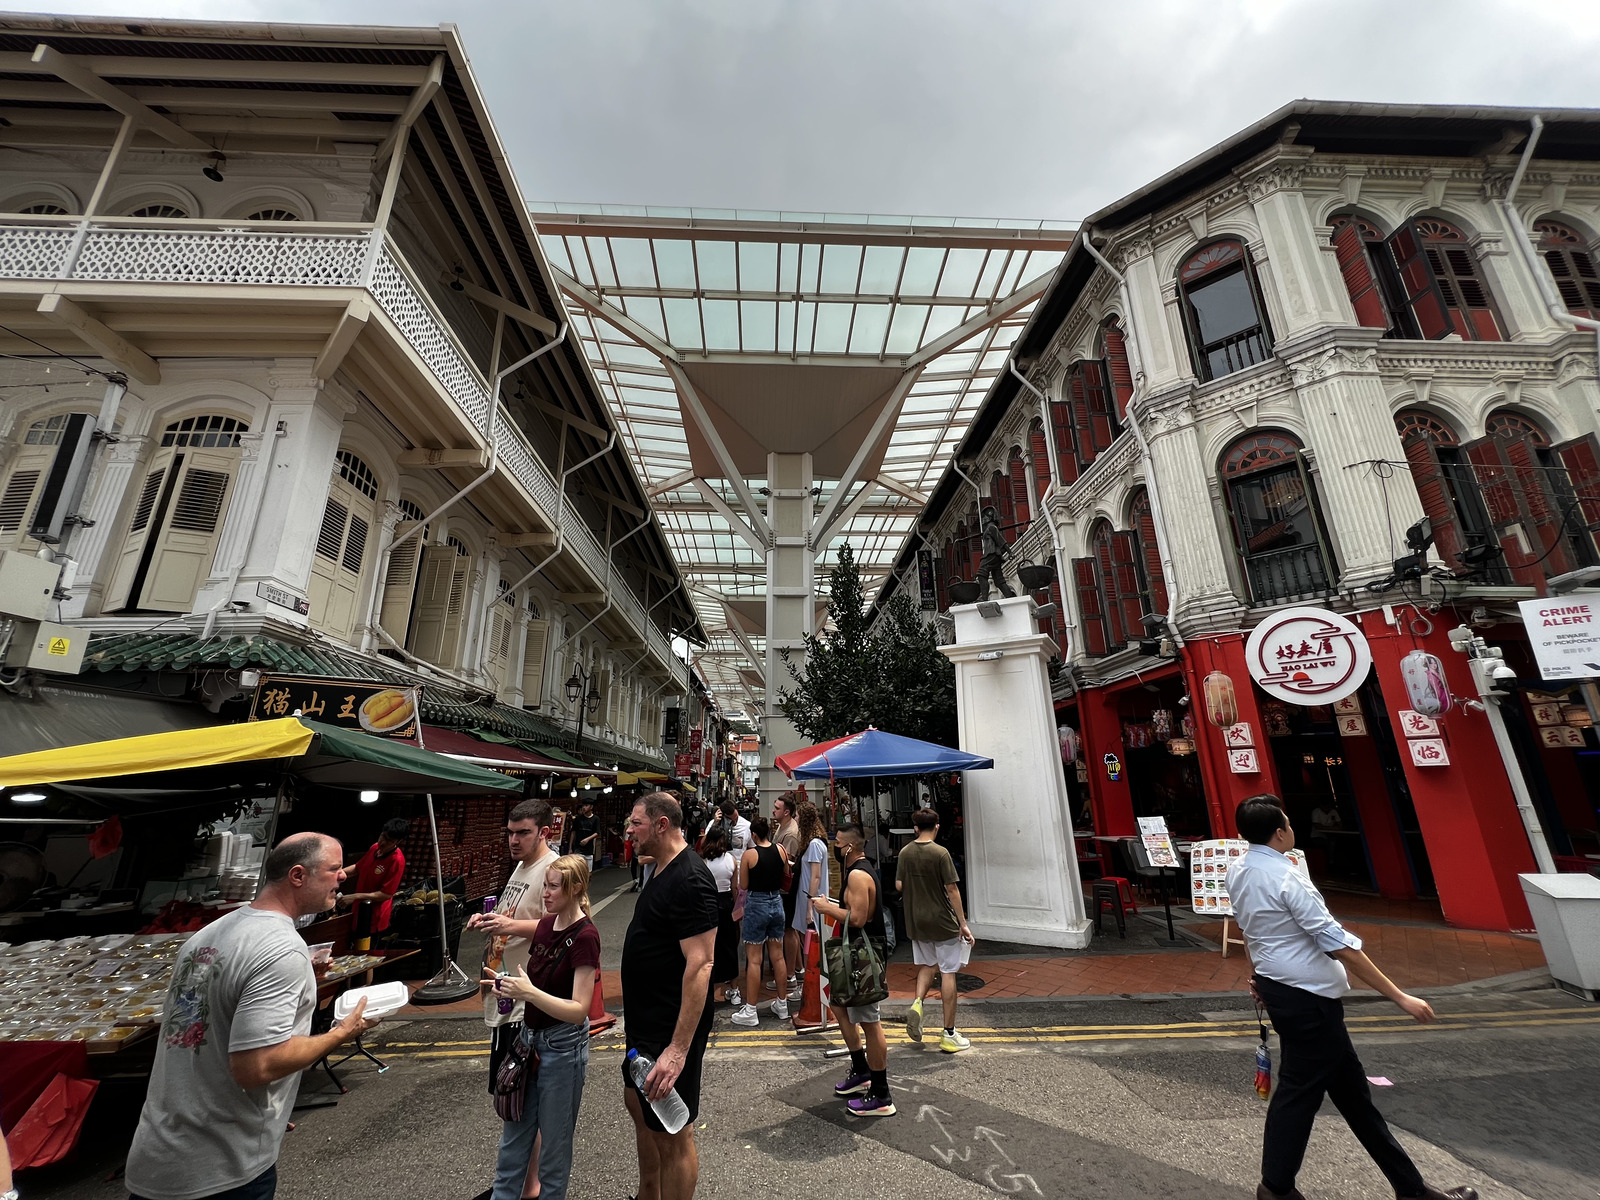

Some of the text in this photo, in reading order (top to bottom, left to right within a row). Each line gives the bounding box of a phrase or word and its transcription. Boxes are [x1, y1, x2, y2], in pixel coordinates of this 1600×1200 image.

[266, 586, 282, 597] SMITH
[282, 592, 289, 600] ST
[1539, 605, 1591, 617] CRIME
[1542, 615, 1593, 627] ALERT
[1556, 632, 1589, 640] BEWARE
[1281, 660, 1336, 672] HAO LAI WU
[262, 687, 357, 719] 猫山王
